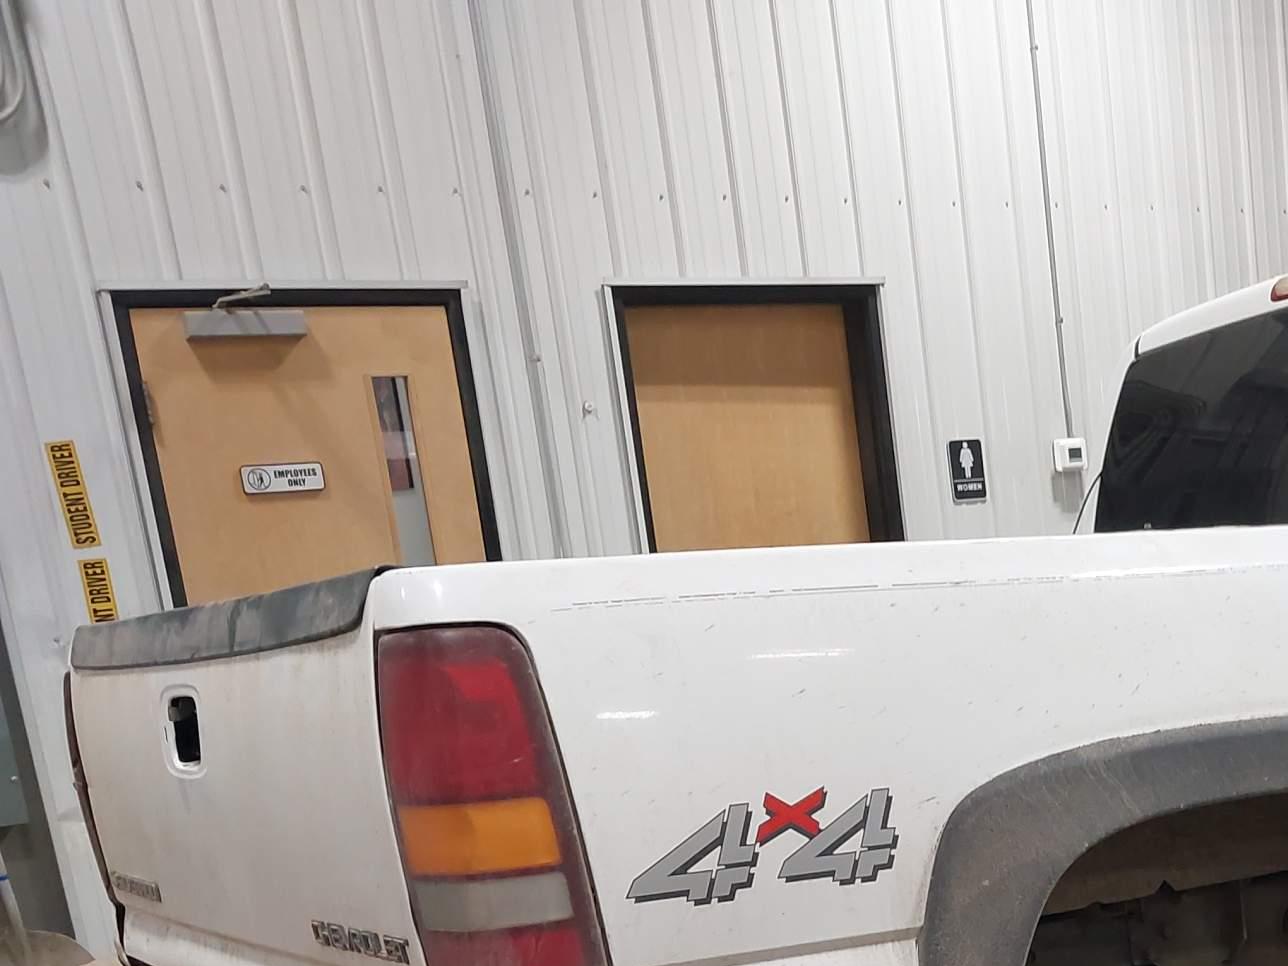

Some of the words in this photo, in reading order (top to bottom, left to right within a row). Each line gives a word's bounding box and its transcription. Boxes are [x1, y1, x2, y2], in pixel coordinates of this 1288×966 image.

[50, 443, 81, 488] DRIVER
[273, 468, 317, 479] EMPLOYEES
[287, 478, 306, 487] ONLY
[957, 483, 982, 491] WOMEN
[62, 492, 97, 545] STUDENT
[83, 561, 112, 604] DRIVER
